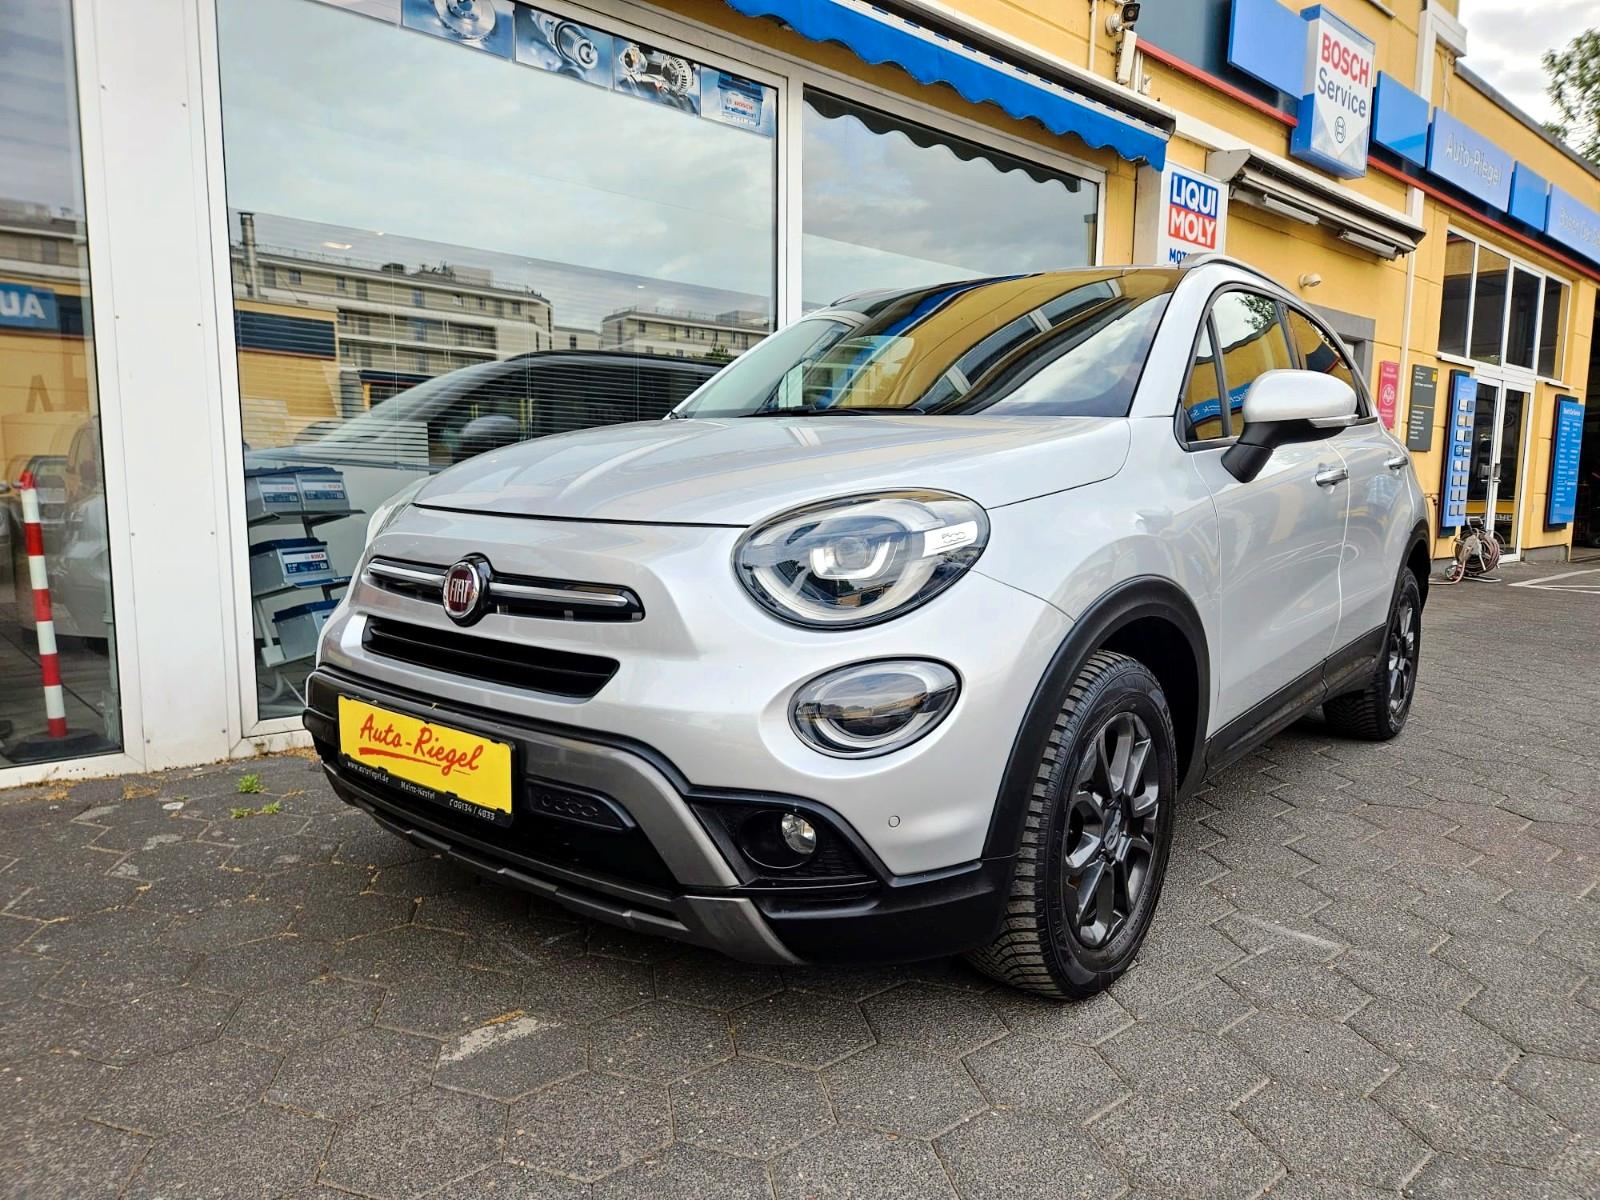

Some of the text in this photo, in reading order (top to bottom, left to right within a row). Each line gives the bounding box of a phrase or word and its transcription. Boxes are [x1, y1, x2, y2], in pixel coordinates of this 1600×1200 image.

[1321, 32, 1370, 88] BOSCH
[1318, 67, 1367, 118] Service
[1446, 133, 1504, 186] Auto-Riegel
[1172, 175, 1217, 217] LIQUI
[1170, 207, 1216, 246] MOLY
[449, 578, 472, 604] FIAT
[360, 713, 483, 776] Auto-Riegel
